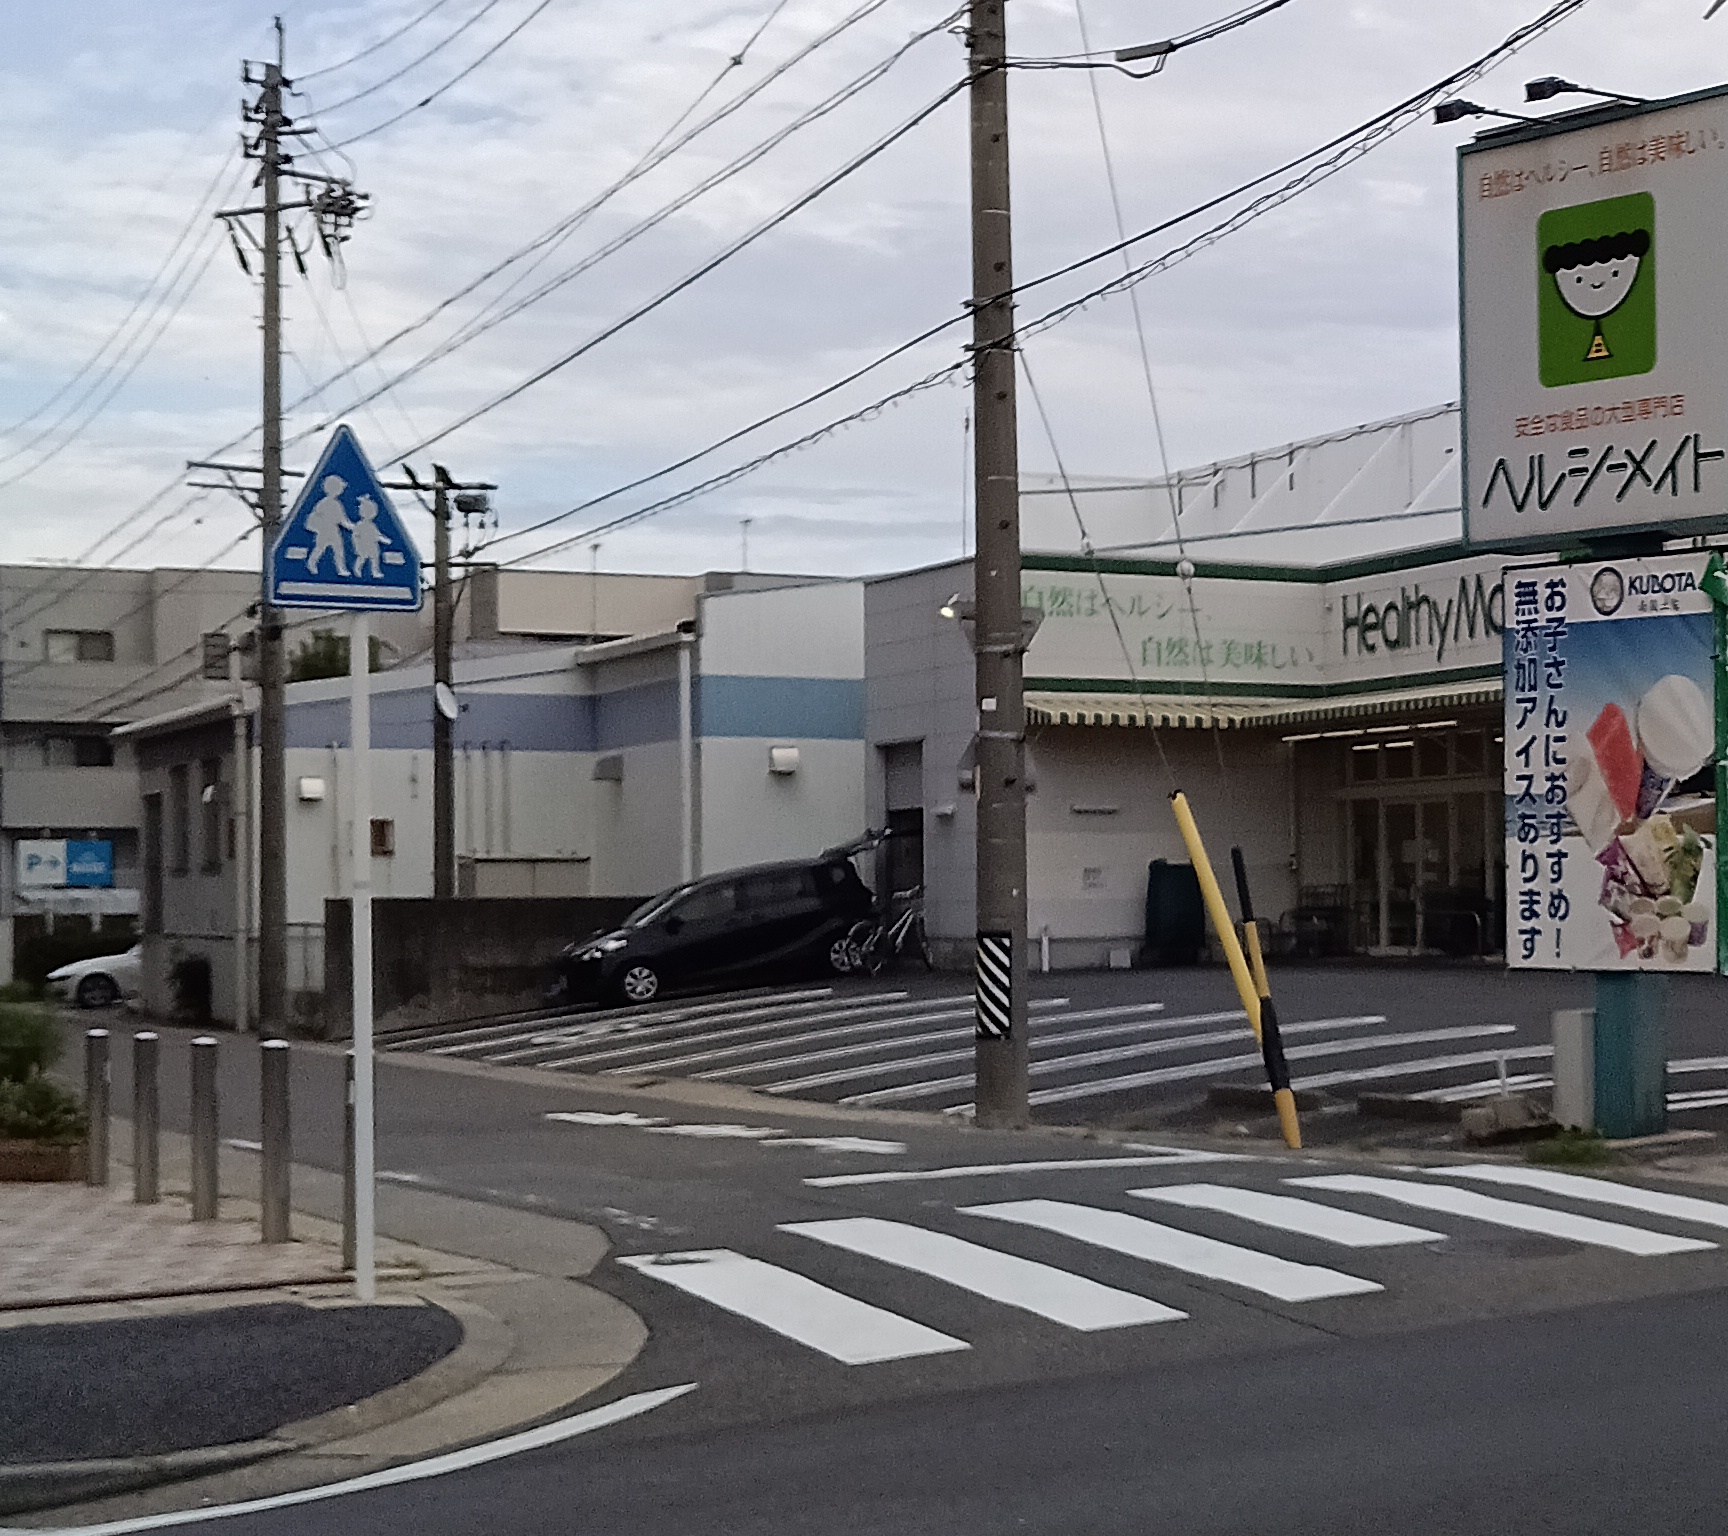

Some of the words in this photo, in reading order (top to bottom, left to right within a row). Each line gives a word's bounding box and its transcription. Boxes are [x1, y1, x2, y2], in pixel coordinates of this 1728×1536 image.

[1481, 434, 1726, 512] ヘルシーメイト
[1628, 571, 1697, 596] KUBOTA
[1514, 580, 1542, 961] 無添加アイスあります
